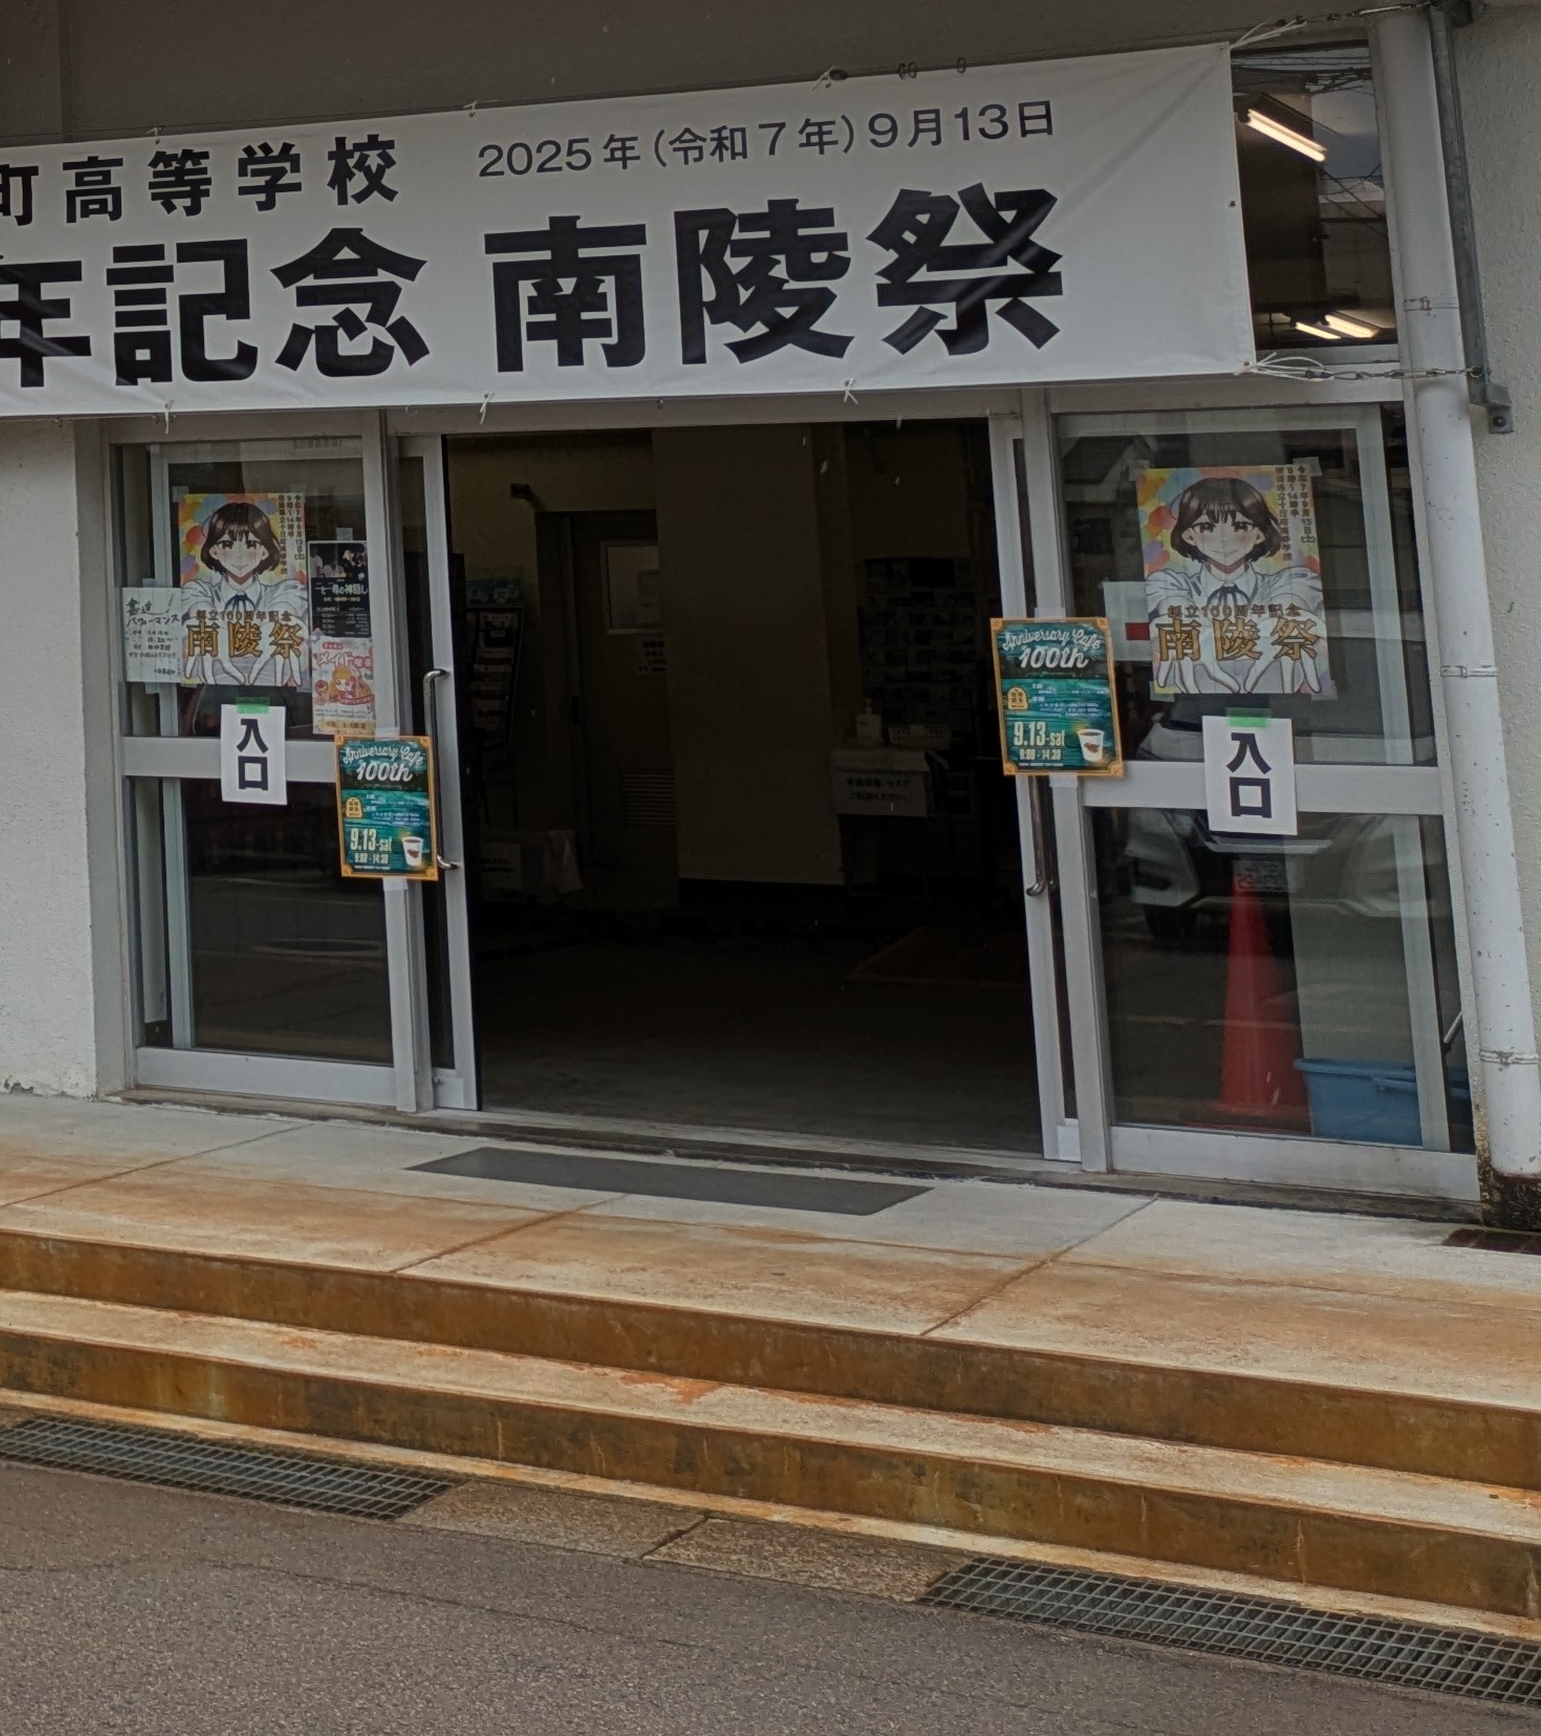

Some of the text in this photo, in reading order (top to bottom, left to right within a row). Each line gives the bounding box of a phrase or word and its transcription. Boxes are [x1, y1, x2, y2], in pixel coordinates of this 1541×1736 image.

[483, 183, 1065, 375] 南陵祭
[186, 621, 304, 659] 南陵祭
[1019, 647, 1089, 668] 100th
[1155, 617, 1319, 662] 南陵祭
[236, 718, 269, 791] 入口
[357, 763, 413, 781] 100th
[1226, 732, 1272, 818] 入口
